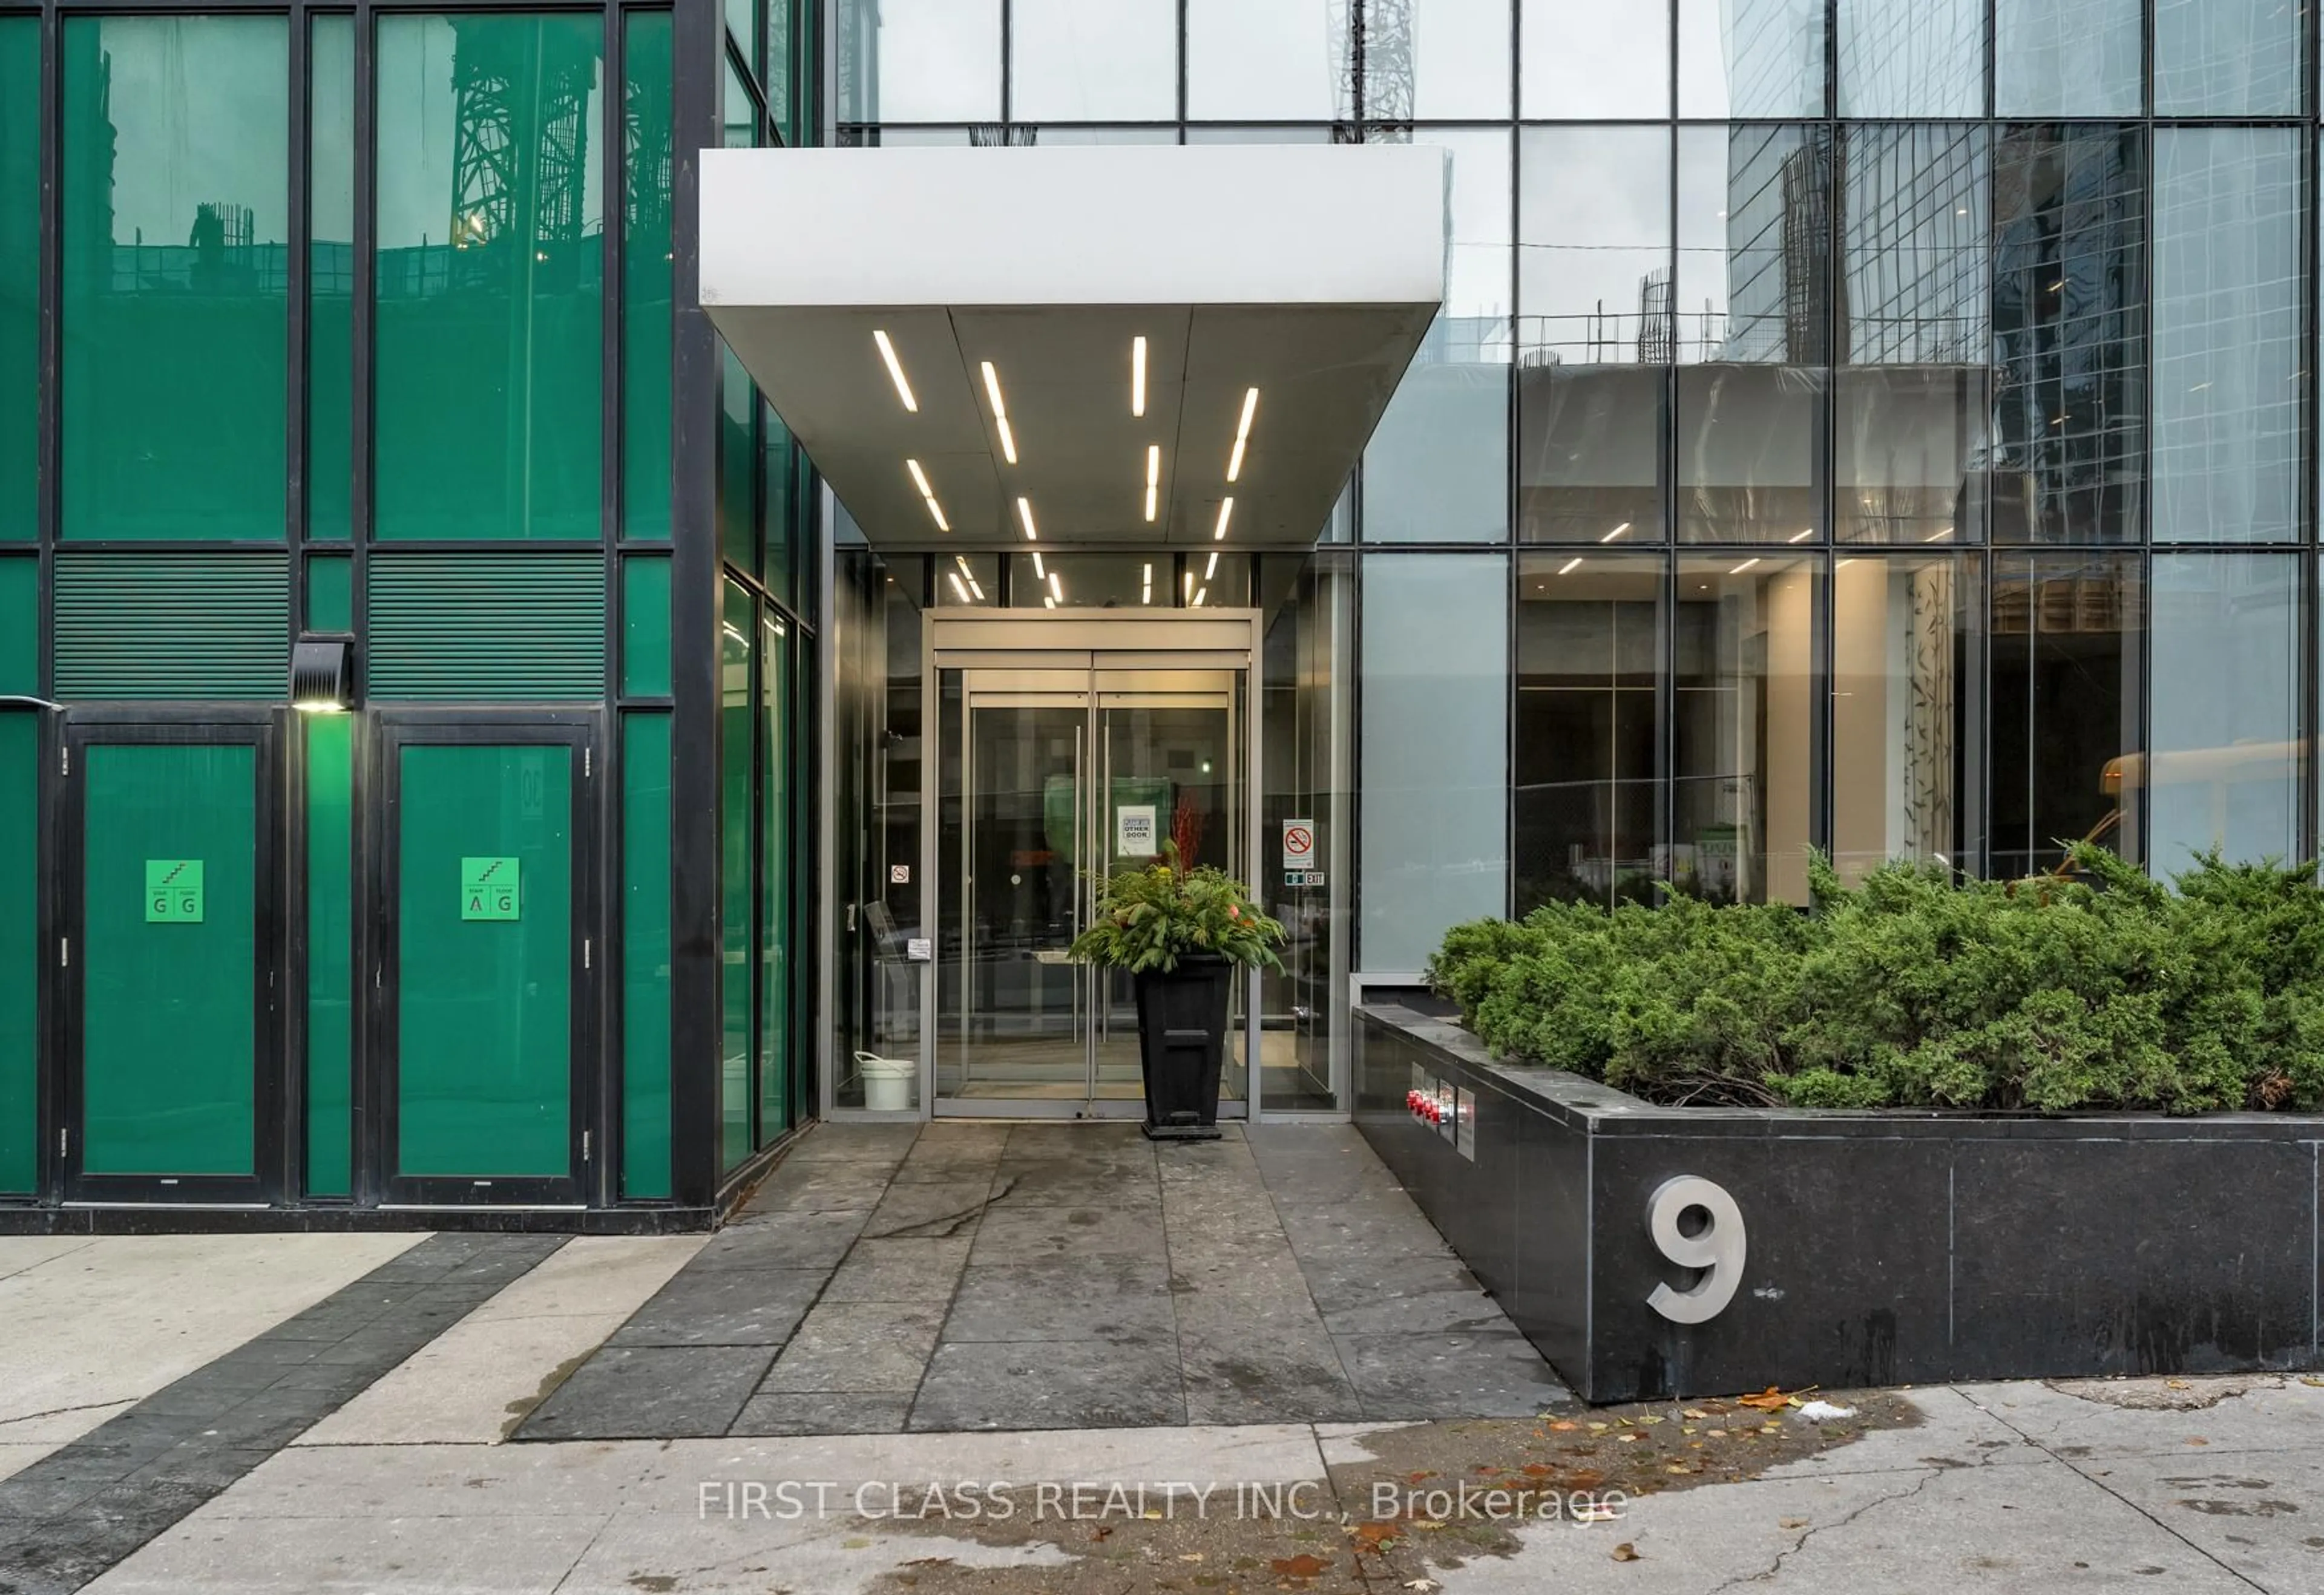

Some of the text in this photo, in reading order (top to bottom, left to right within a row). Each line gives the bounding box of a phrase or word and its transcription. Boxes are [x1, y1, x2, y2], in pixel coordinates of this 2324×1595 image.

[1307, 874, 1323, 883] EXIT
[154, 898, 166, 913] G
[182, 898, 195, 913] G
[470, 896, 482, 911] A
[498, 896, 511, 912] G
[1646, 1174, 1747, 1324] 9
